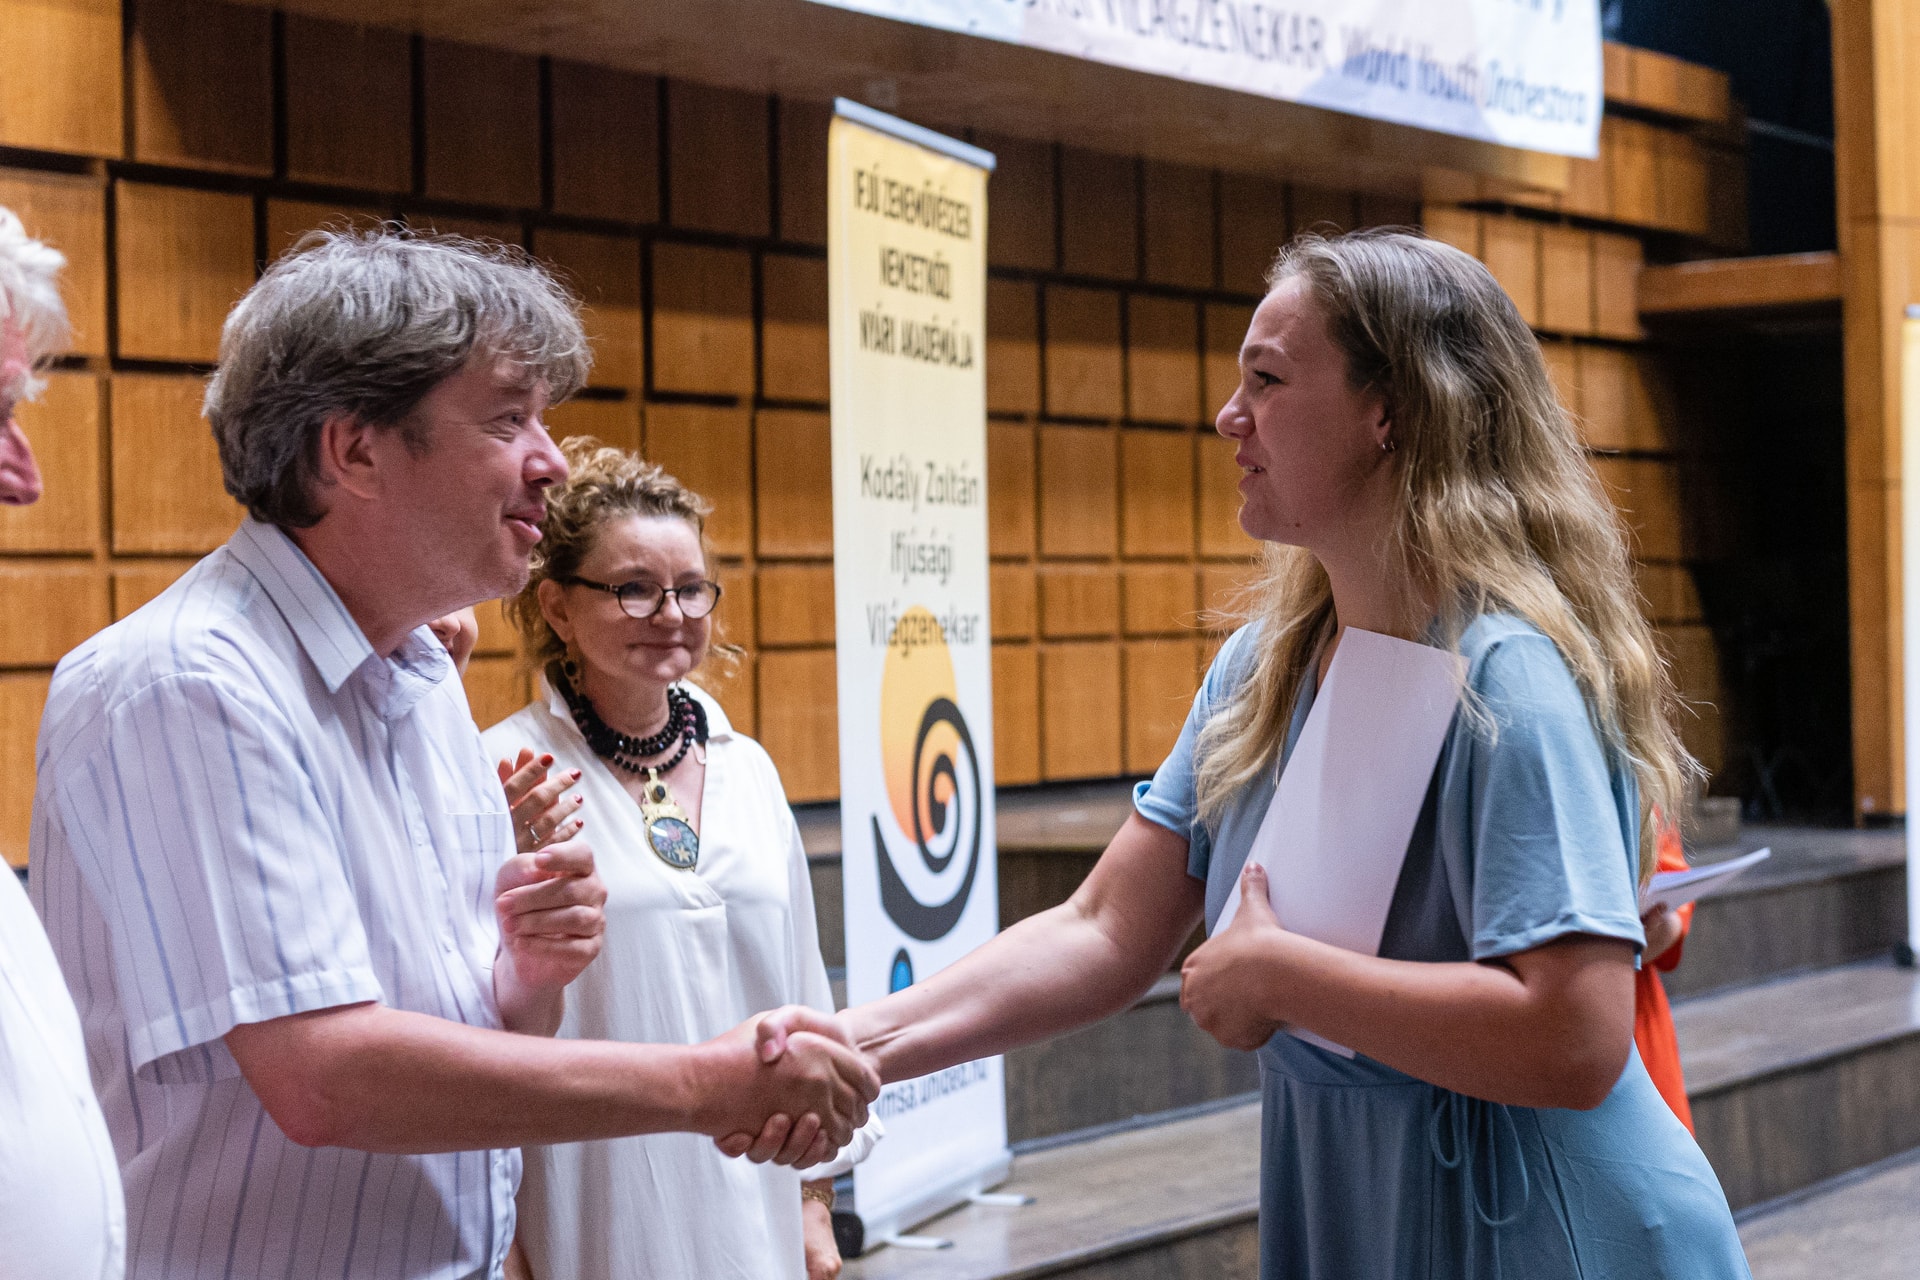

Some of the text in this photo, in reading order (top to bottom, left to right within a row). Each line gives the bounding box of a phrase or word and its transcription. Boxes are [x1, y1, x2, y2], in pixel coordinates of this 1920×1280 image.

[861, 452, 978, 514] Kodály Zoltán
[891, 526, 952, 586] Ifjúsági
[866, 598, 979, 658] Világzenekar
